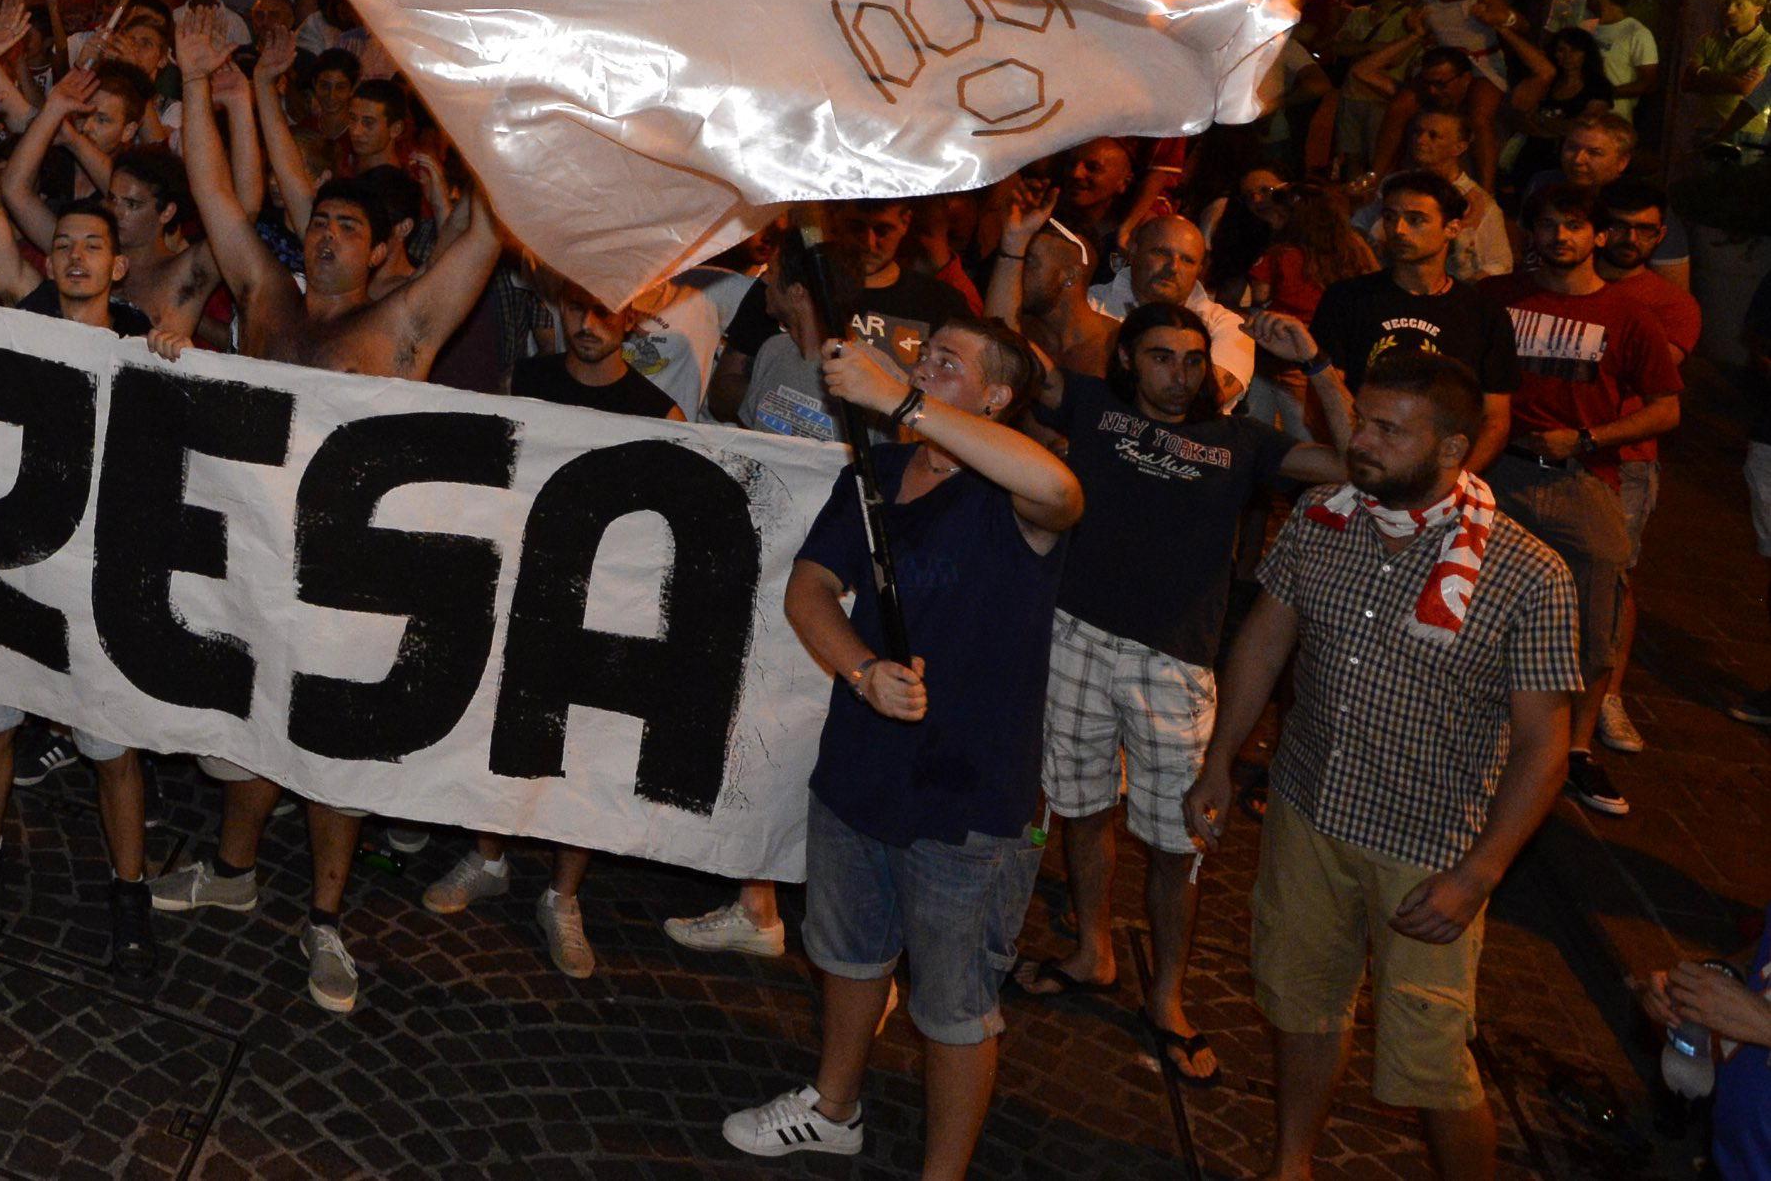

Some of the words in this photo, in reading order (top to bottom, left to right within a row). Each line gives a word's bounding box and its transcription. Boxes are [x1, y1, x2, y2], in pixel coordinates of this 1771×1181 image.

[1381, 317, 1441, 337] VECCHIE
[1097, 411, 1150, 437] NEW
[1152, 427, 1234, 469] YORKER
[1146, 451, 1202, 478] Mello
